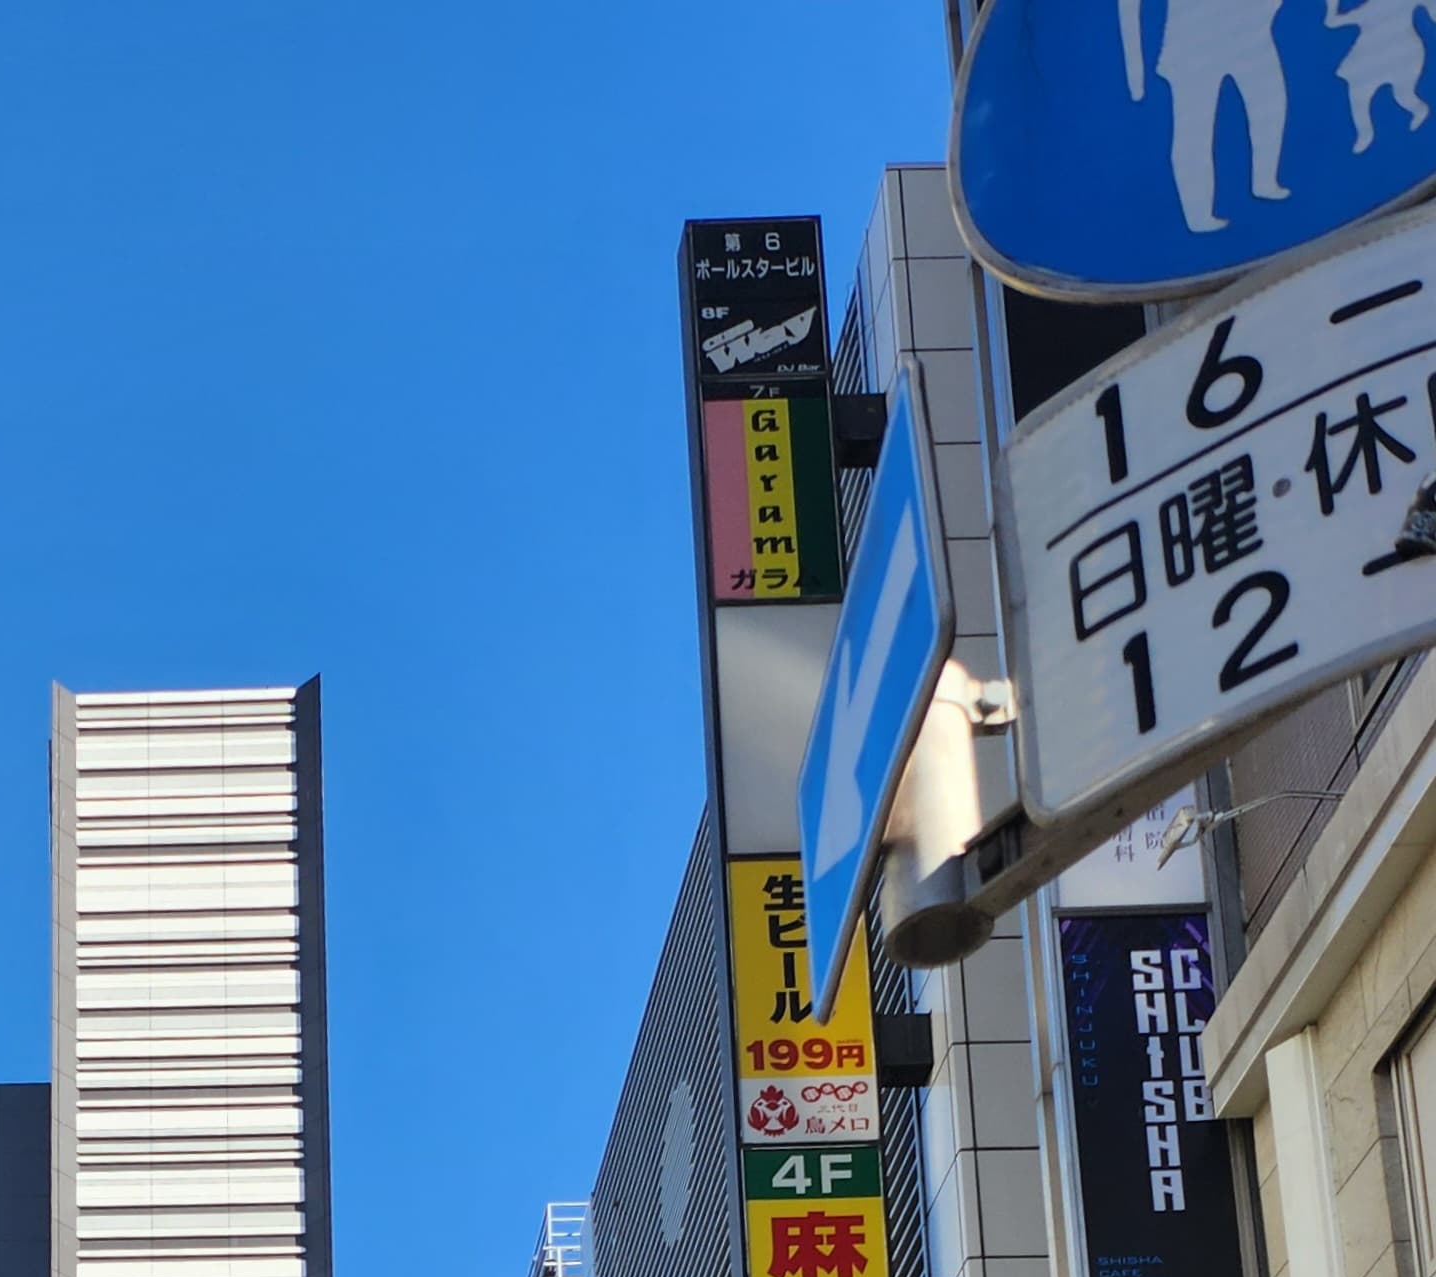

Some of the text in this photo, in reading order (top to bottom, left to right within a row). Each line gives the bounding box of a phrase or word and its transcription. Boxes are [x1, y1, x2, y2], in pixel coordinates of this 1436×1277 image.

[701, 307, 729, 320] 8F
[750, 385, 780, 399] 7F
[751, 408, 796, 555] Garam
[730, 568, 822, 592] ガラム
[745, 1037, 866, 1072] 199円
[804, 1116, 870, 1135] 鳥メロ
[771, 1153, 854, 1195] 4F
